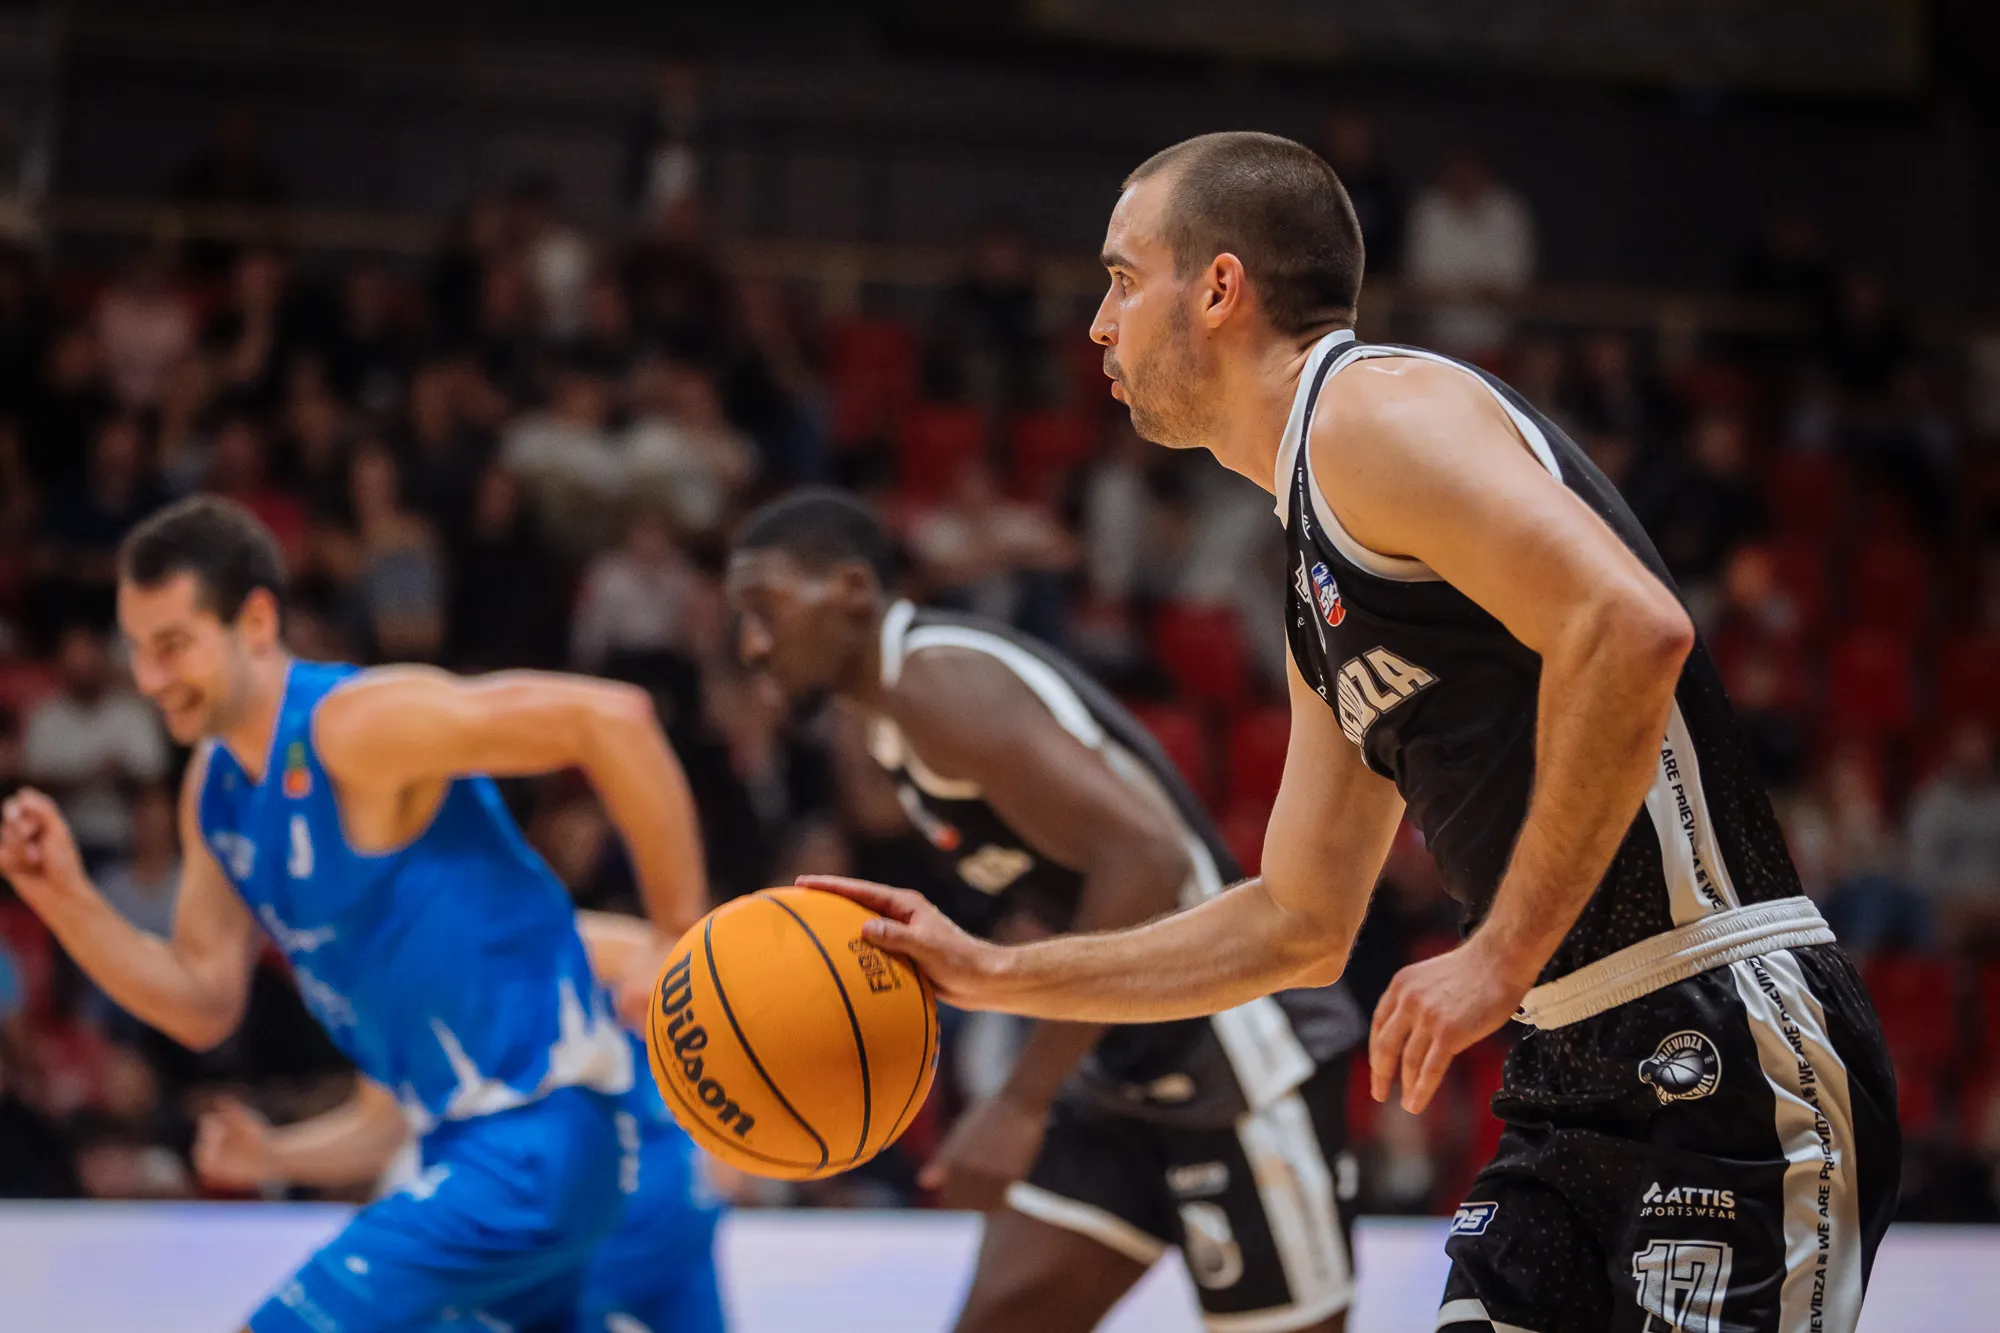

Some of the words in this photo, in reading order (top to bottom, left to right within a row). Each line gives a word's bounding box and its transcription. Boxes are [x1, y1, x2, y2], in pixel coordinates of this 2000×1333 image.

[1661, 749, 1680, 781] ARE
[1701, 881, 1725, 910] WE
[661, 951, 755, 1138] Wilson
[1651, 1035, 1703, 1065] PRIEVIDZA
[1783, 1025, 1804, 1055] ARE
[1797, 1058, 1817, 1086] WE
[1664, 1186, 1736, 1208] ATTIS
[1818, 1185, 1831, 1218] ARE
[1640, 1207, 1736, 1221] SPORTSWEAR
[1817, 1222, 1830, 1250] WE
[1632, 1239, 1733, 1333] 17
[1810, 1268, 1826, 1333] IEVIDZA
